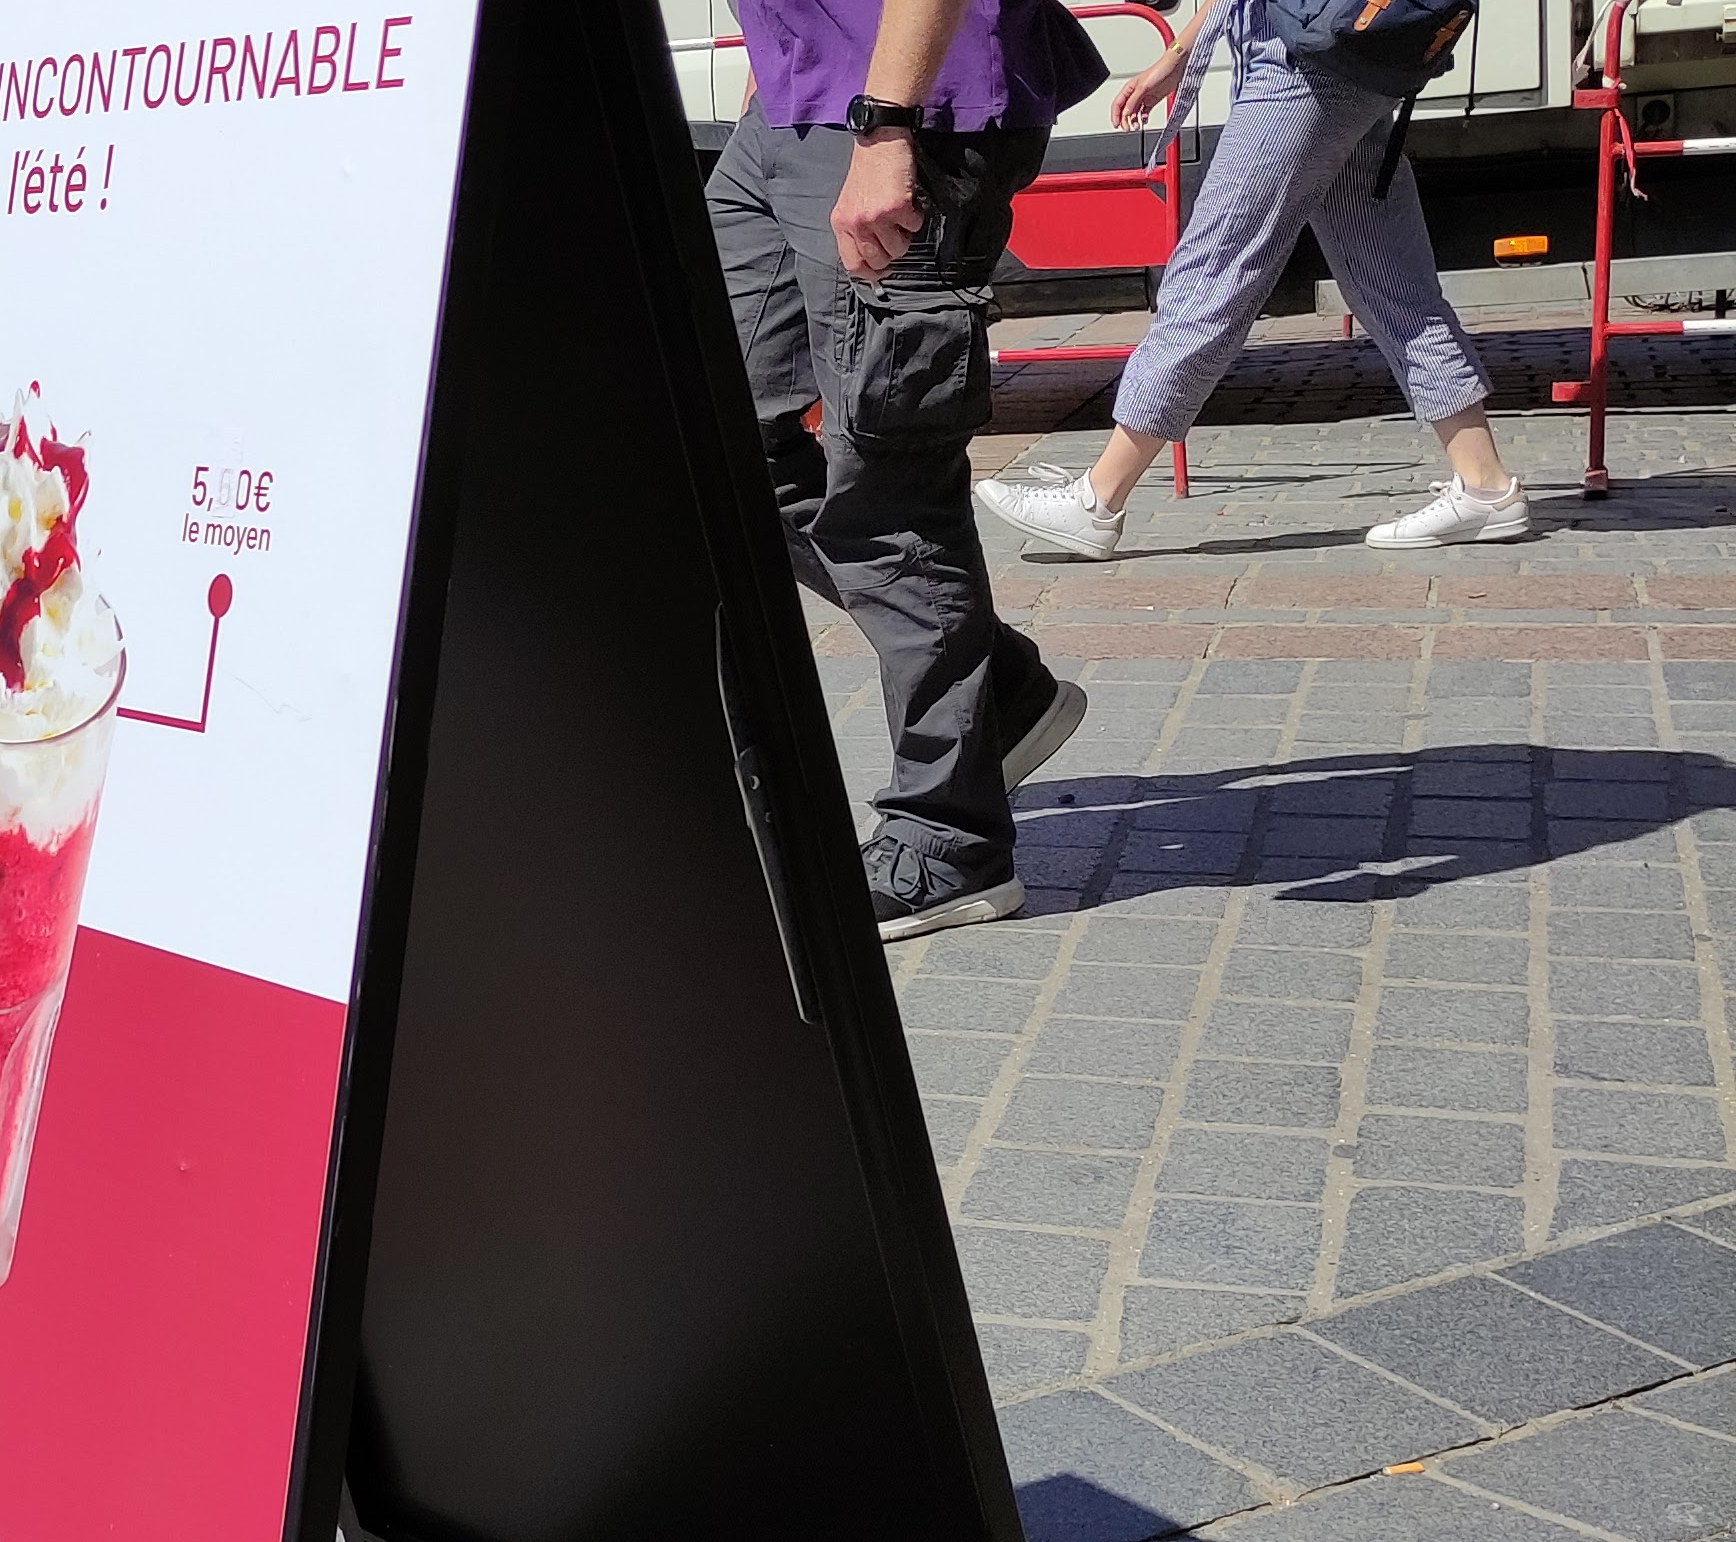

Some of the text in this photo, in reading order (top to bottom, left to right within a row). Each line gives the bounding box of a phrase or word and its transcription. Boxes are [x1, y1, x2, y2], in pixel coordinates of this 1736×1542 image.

[7, 146, 88, 215] l'été
[99, 144, 115, 211] !
[181, 513, 271, 556] le moyen
